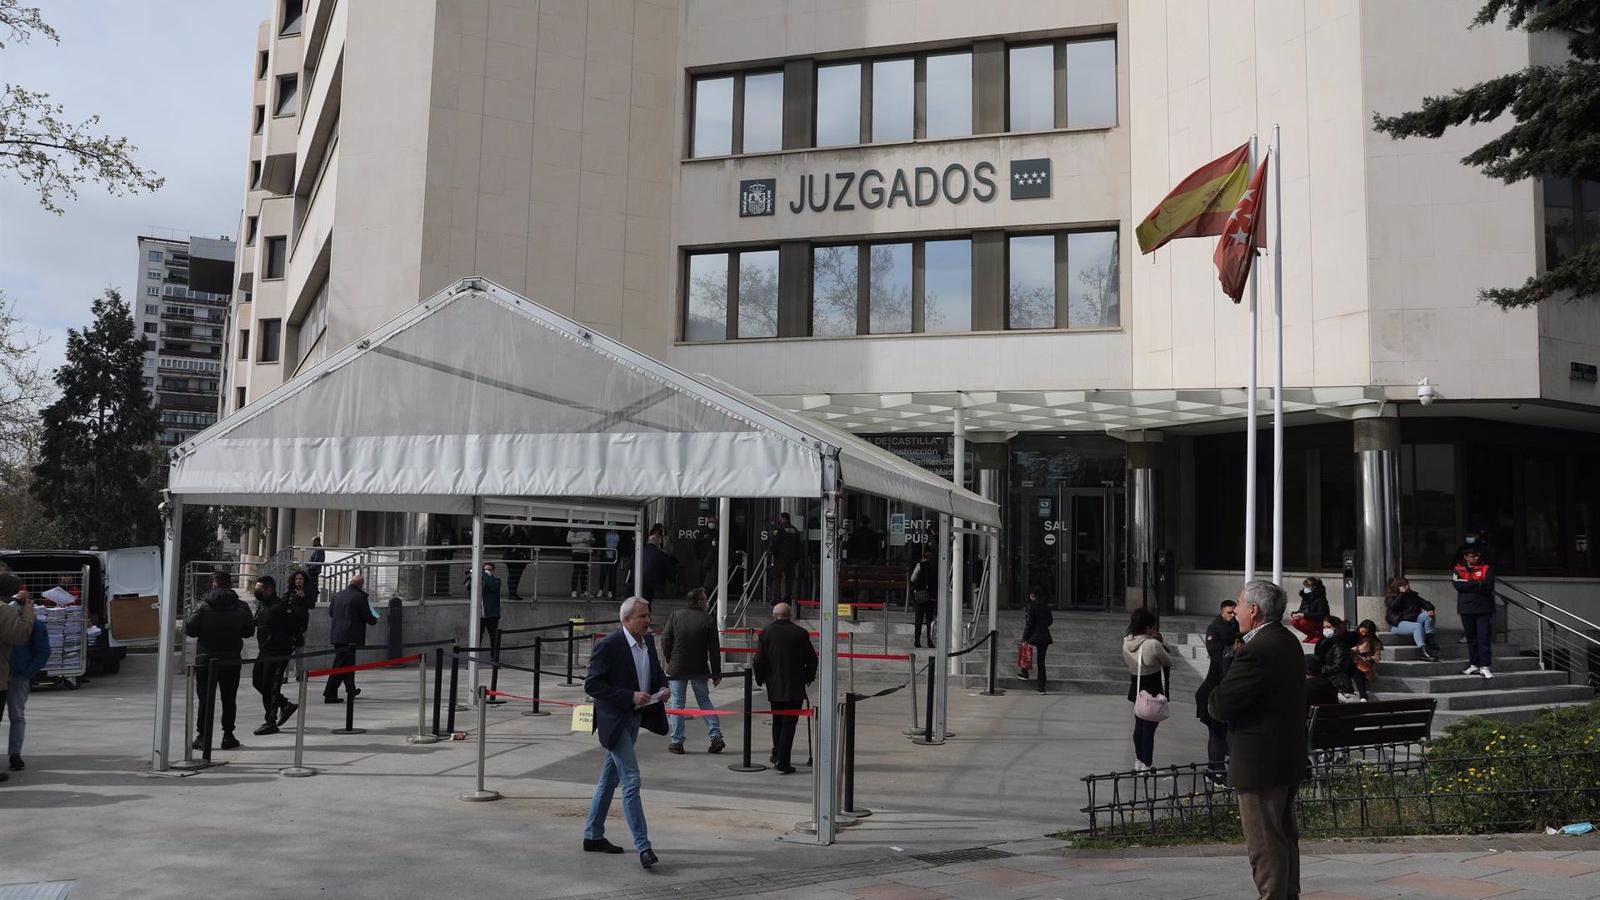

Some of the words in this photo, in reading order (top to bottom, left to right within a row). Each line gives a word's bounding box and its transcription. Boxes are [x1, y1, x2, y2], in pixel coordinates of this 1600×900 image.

[789, 160, 996, 214] JUZGADOS
[874, 437, 888, 445] DE
[891, 437, 937, 445] CASTILLA
